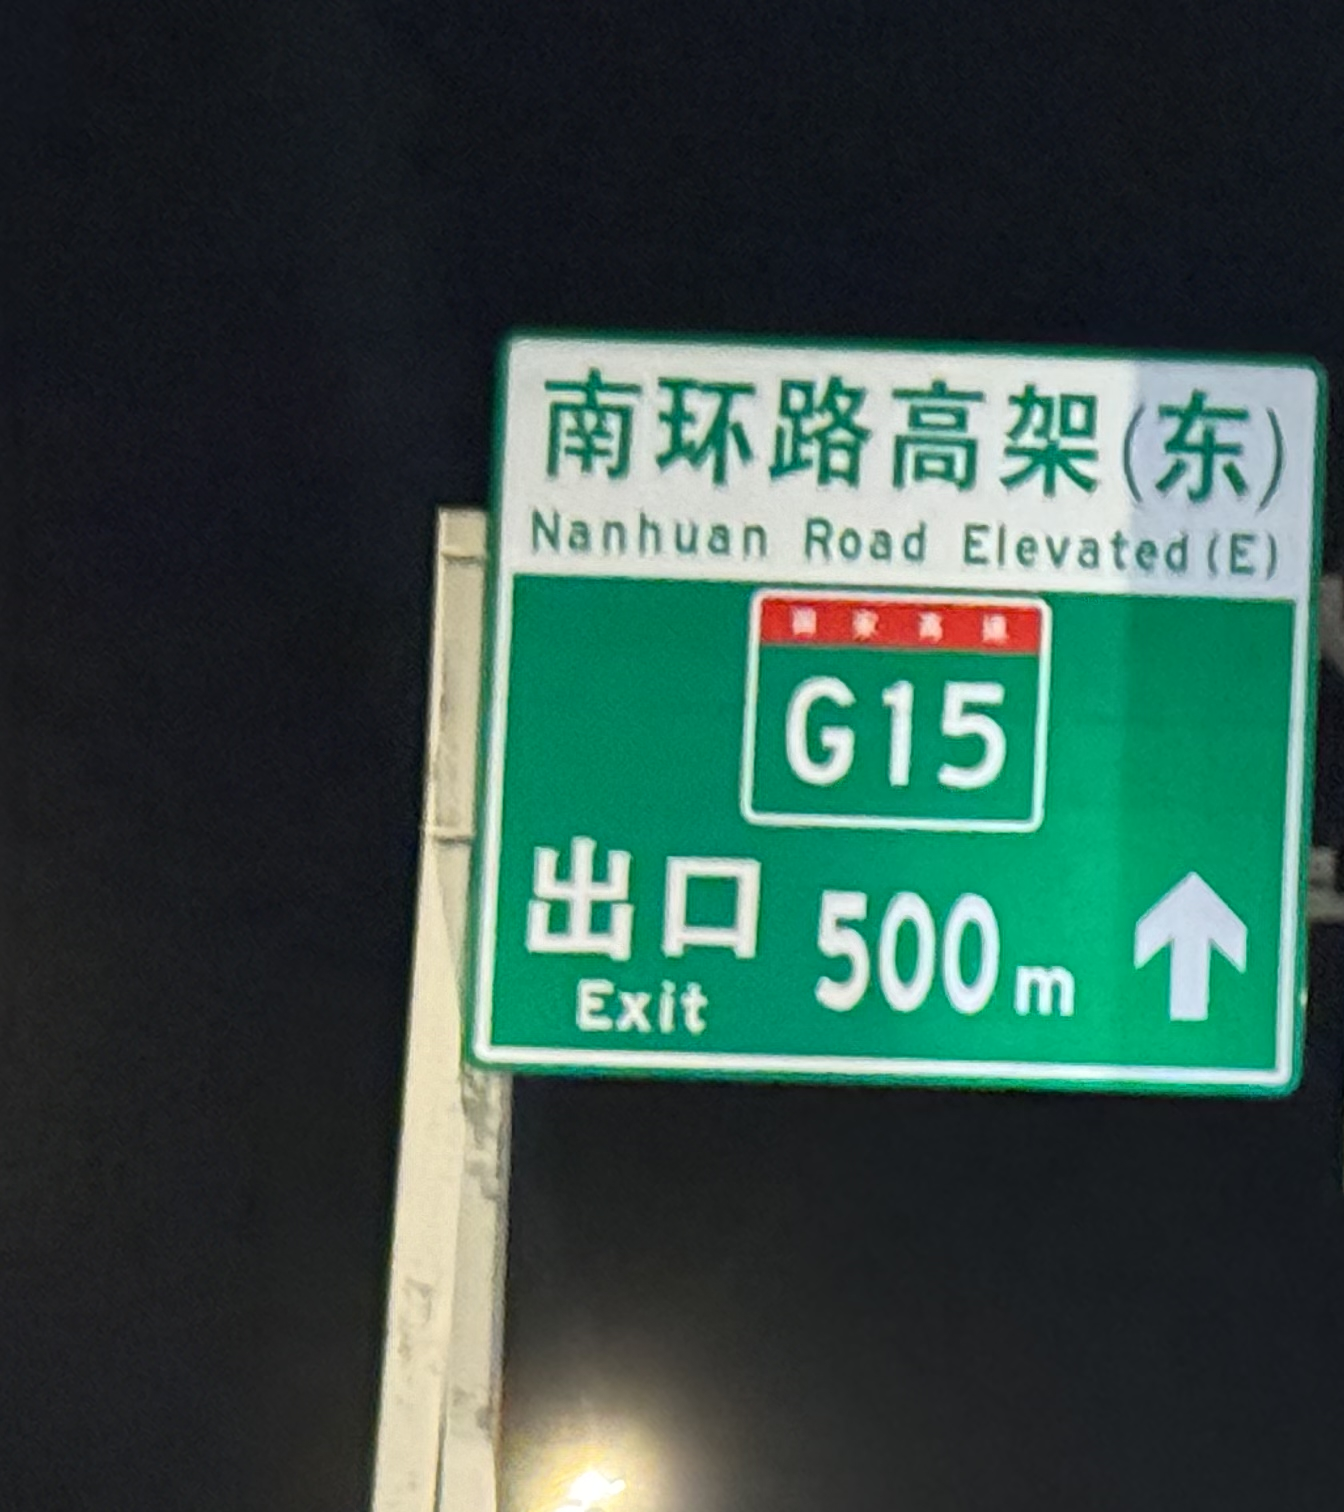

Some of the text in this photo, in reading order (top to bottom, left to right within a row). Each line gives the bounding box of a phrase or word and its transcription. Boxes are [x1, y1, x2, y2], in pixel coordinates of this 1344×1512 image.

[543, 368, 1286, 513] 南环路高架(东)
[531, 508, 768, 558] Nanhuan
[803, 516, 928, 563] Road
[784, 676, 1007, 790] G15
[525, 835, 762, 962] 出口
[813, 890, 1075, 1019] 500 m
[575, 980, 708, 1034] Exit
